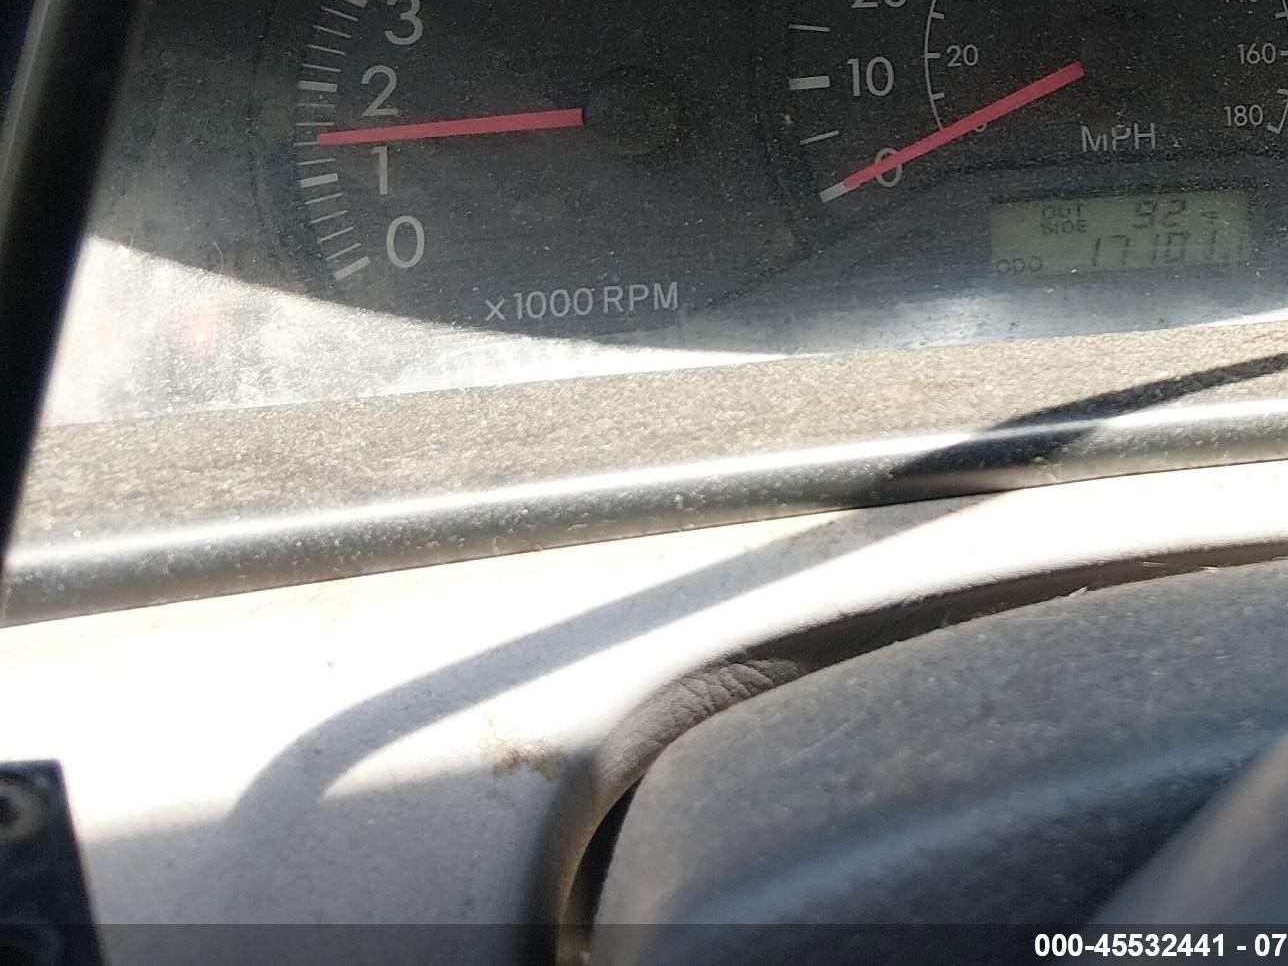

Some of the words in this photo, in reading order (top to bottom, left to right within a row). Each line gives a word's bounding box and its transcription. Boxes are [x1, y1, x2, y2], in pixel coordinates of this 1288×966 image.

[947, 45, 978, 67] 20
[1238, 44, 1277, 64] 160
[360, 65, 399, 117] 2
[847, 59, 894, 97] 10
[1225, 105, 1264, 127] 180
[1081, 123, 1156, 153] MPH
[372, 145, 388, 195] 1
[1042, 204, 1082, 220] OUT
[1041, 219, 1088, 235] SIDE
[386, 215, 425, 268] 0
[996, 256, 1043, 275] ODO
[603, 281, 679, 312] RPM
